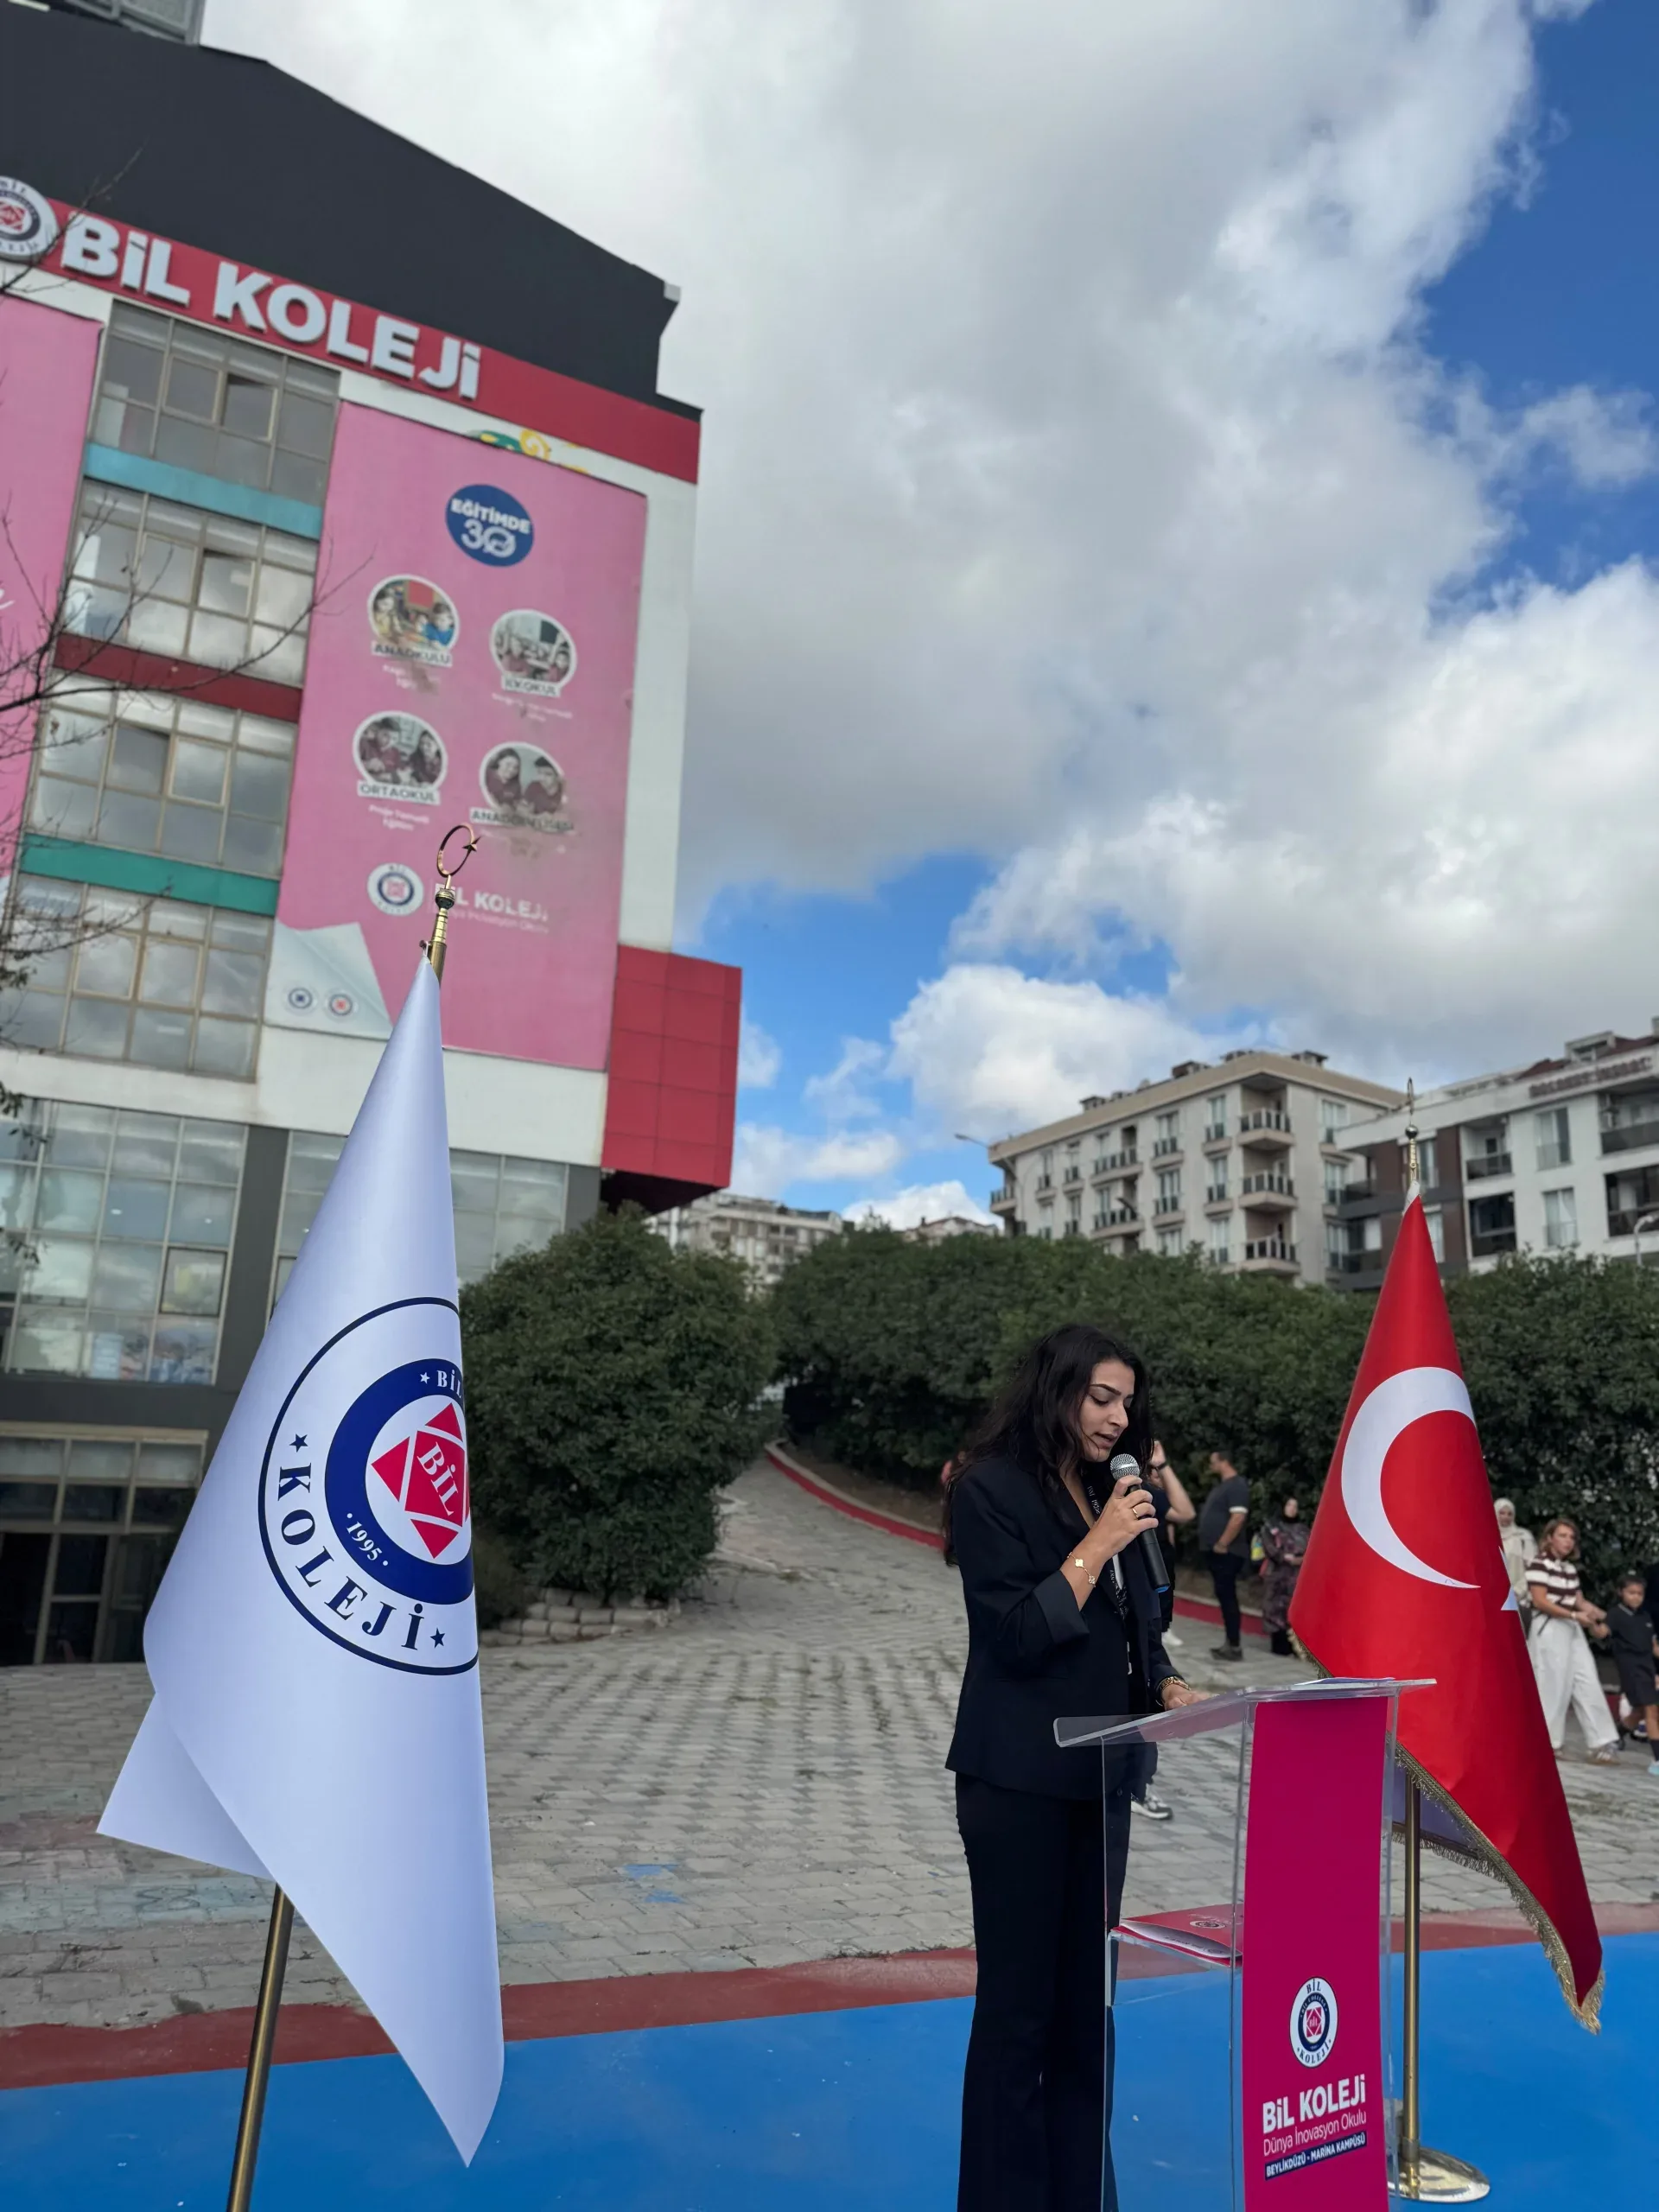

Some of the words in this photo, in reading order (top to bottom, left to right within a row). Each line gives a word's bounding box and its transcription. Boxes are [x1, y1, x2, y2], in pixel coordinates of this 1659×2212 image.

[416, 1440, 459, 1516] BİL
[276, 1461, 426, 1651] KOLEJİ
[346, 1520, 383, 1562] 1995
[1306, 1978, 1322, 1994] BİL
[1263, 2134, 1294, 2157] Dünya
[1294, 2120, 1340, 2145] İnovasyon
[1341, 2108, 1367, 2131] Okulu
[1336, 2132, 1365, 2153] KAMPÜSÜ
